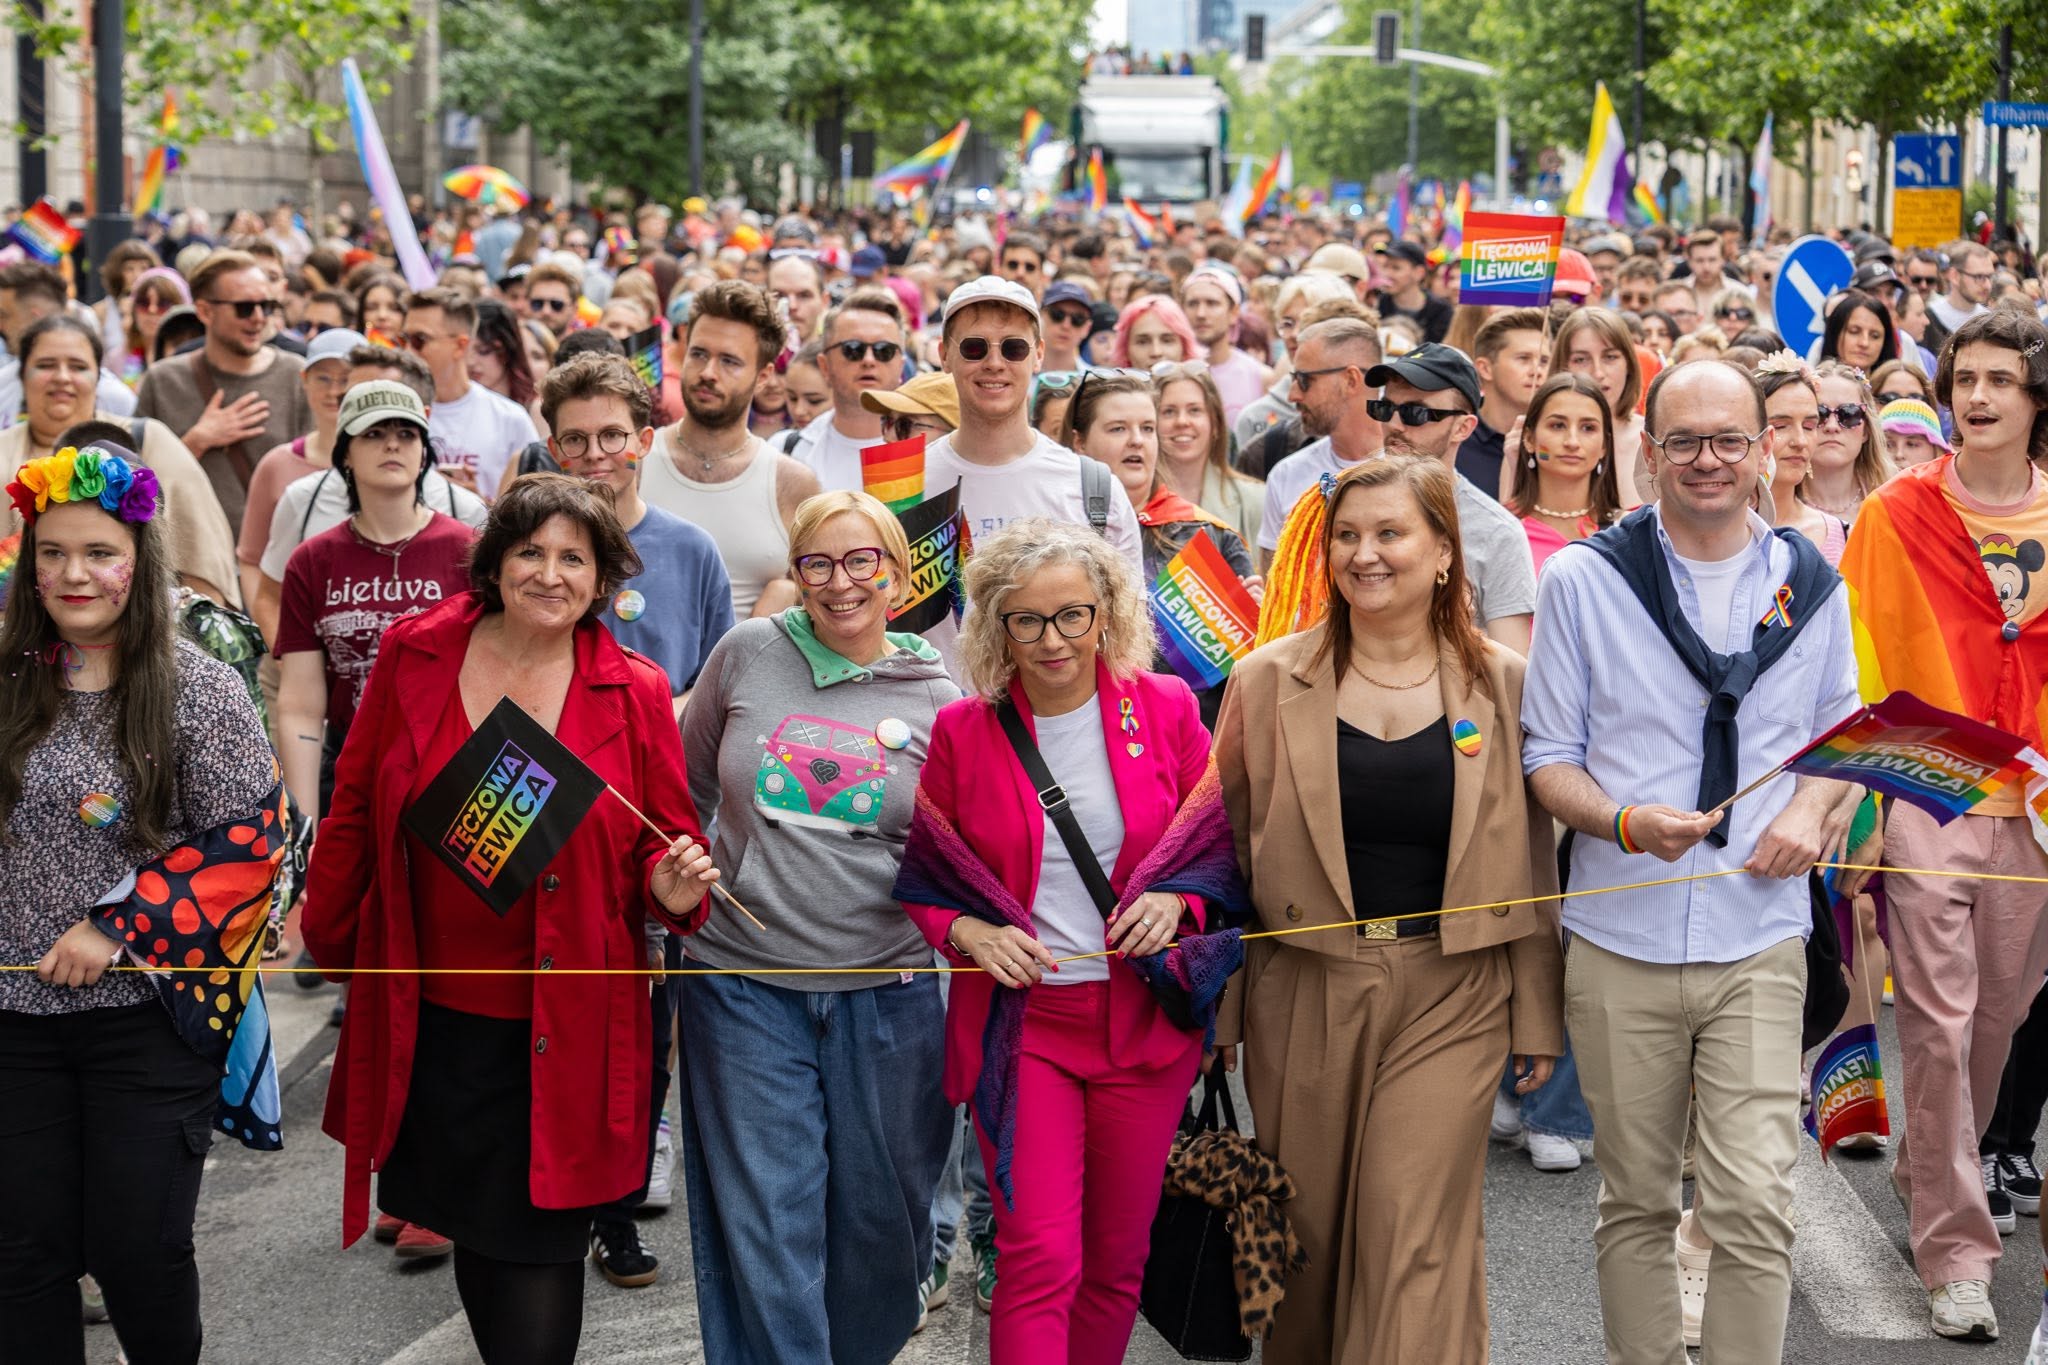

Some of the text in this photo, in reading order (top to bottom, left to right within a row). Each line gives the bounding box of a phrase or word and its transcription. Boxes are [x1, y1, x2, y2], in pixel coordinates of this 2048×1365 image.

[1992, 104, 2048, 122] Filharm
[1478, 241, 1547, 262] TĘCZOWA
[1477, 260, 1544, 281] LEWICA
[357, 390, 416, 412] LIETUVA
[910, 523, 957, 567] ZOWA
[325, 576, 442, 606] Lietuva
[1157, 587, 1228, 661] LEWICA
[1179, 574, 1245, 646] TĘCZOWA
[1844, 755, 1966, 791] LEWICA
[1867, 744, 1985, 780] TĘCZOWA
[448, 755, 524, 852] TĘCZOWA
[471, 775, 550, 879] LEWICA
[1817, 1054, 1870, 1112] LEWIC
